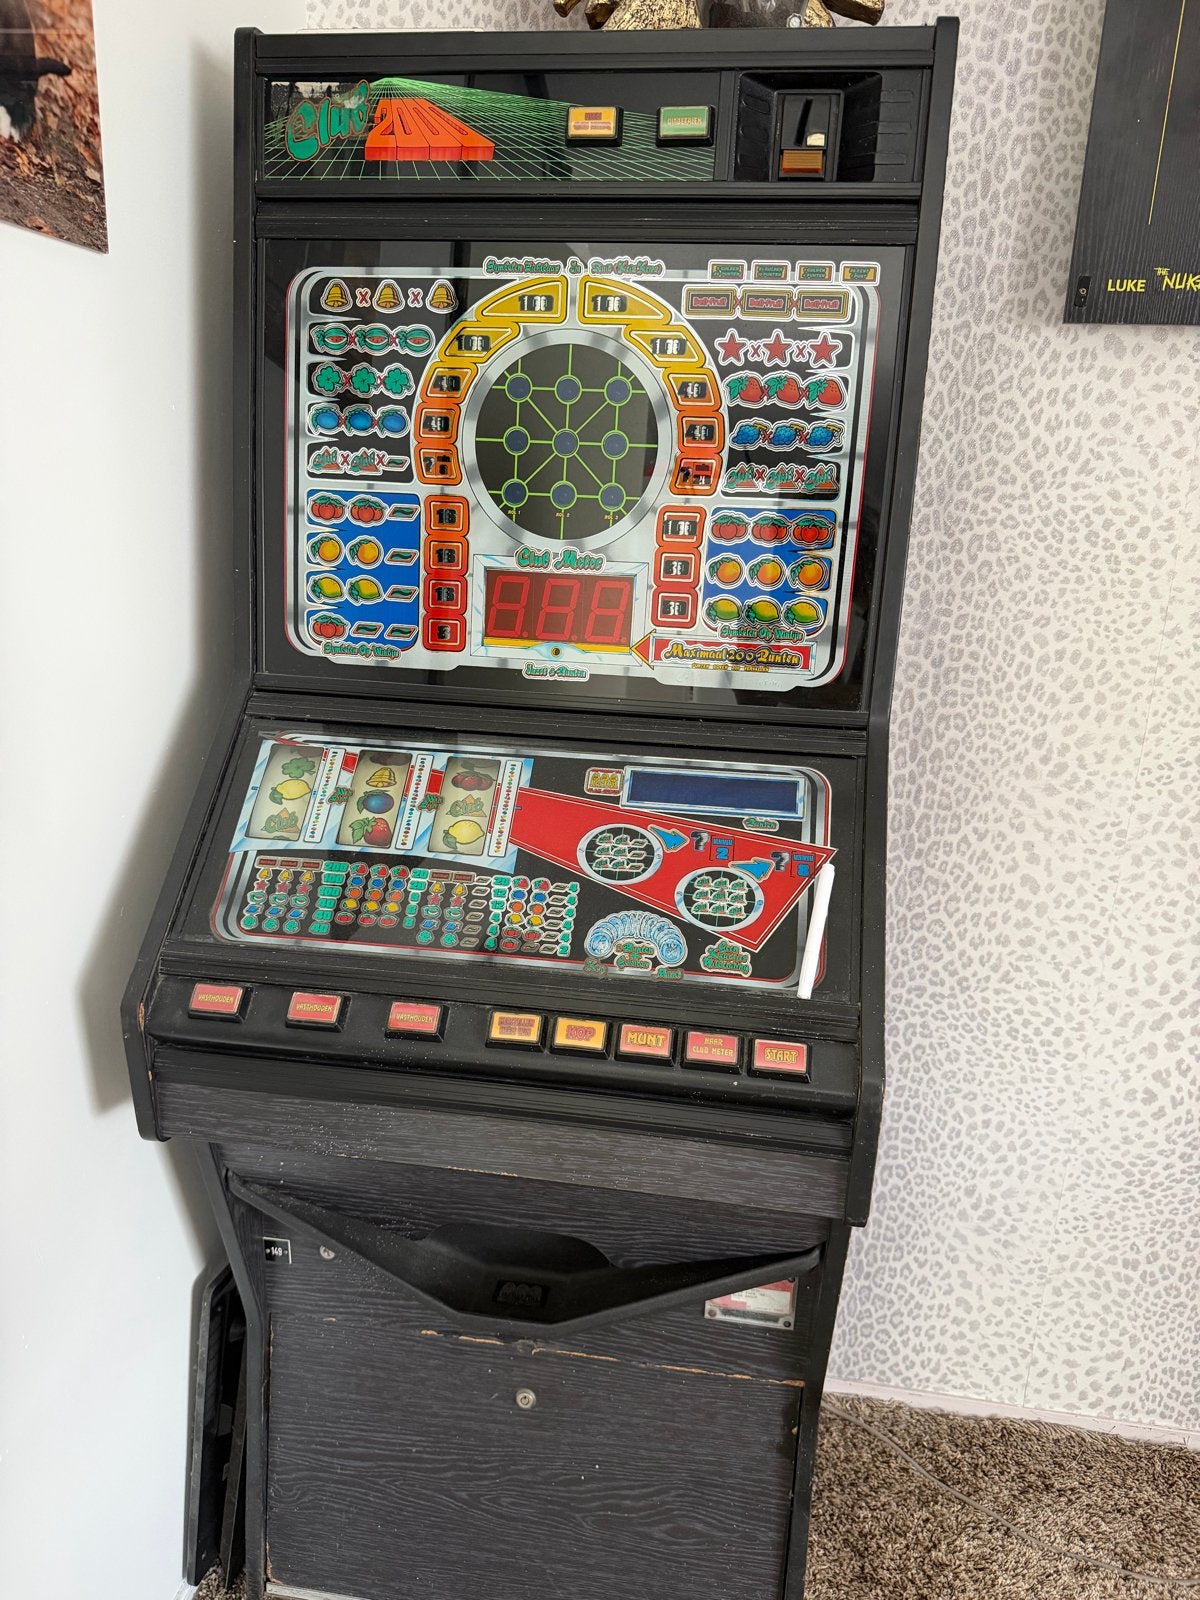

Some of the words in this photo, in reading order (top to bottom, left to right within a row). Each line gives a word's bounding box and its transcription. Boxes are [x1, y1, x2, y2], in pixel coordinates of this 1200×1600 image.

[286, 79, 370, 162] Club
[364, 98, 496, 161] 2000
[1107, 279, 1146, 292] LUKE
[664, 642, 727, 660] Maximaal
[728, 649, 755, 662] 200
[716, 847, 729, 860] 2
[324, 862, 349, 873] 200
[412, 869, 429, 880] 20
[409, 881, 427, 891] 20
[492, 876, 511, 887] 20
[558, 944, 569, 955] 2
[198, 993, 234, 1004] VASTHOUDEN
[296, 1003, 333, 1014] VASTHOUDEN
[395, 1013, 433, 1024] VASTHOUDEN
[566, 1025, 596, 1040] KOP
[627, 1031, 666, 1047] MUNT
[704, 1037, 724, 1046] NAAR
[692, 1046, 709, 1055] CLUB
[711, 1048, 734, 1057] METER
[764, 1048, 799, 1064] START
[271, 1246, 283, 1257] 149
